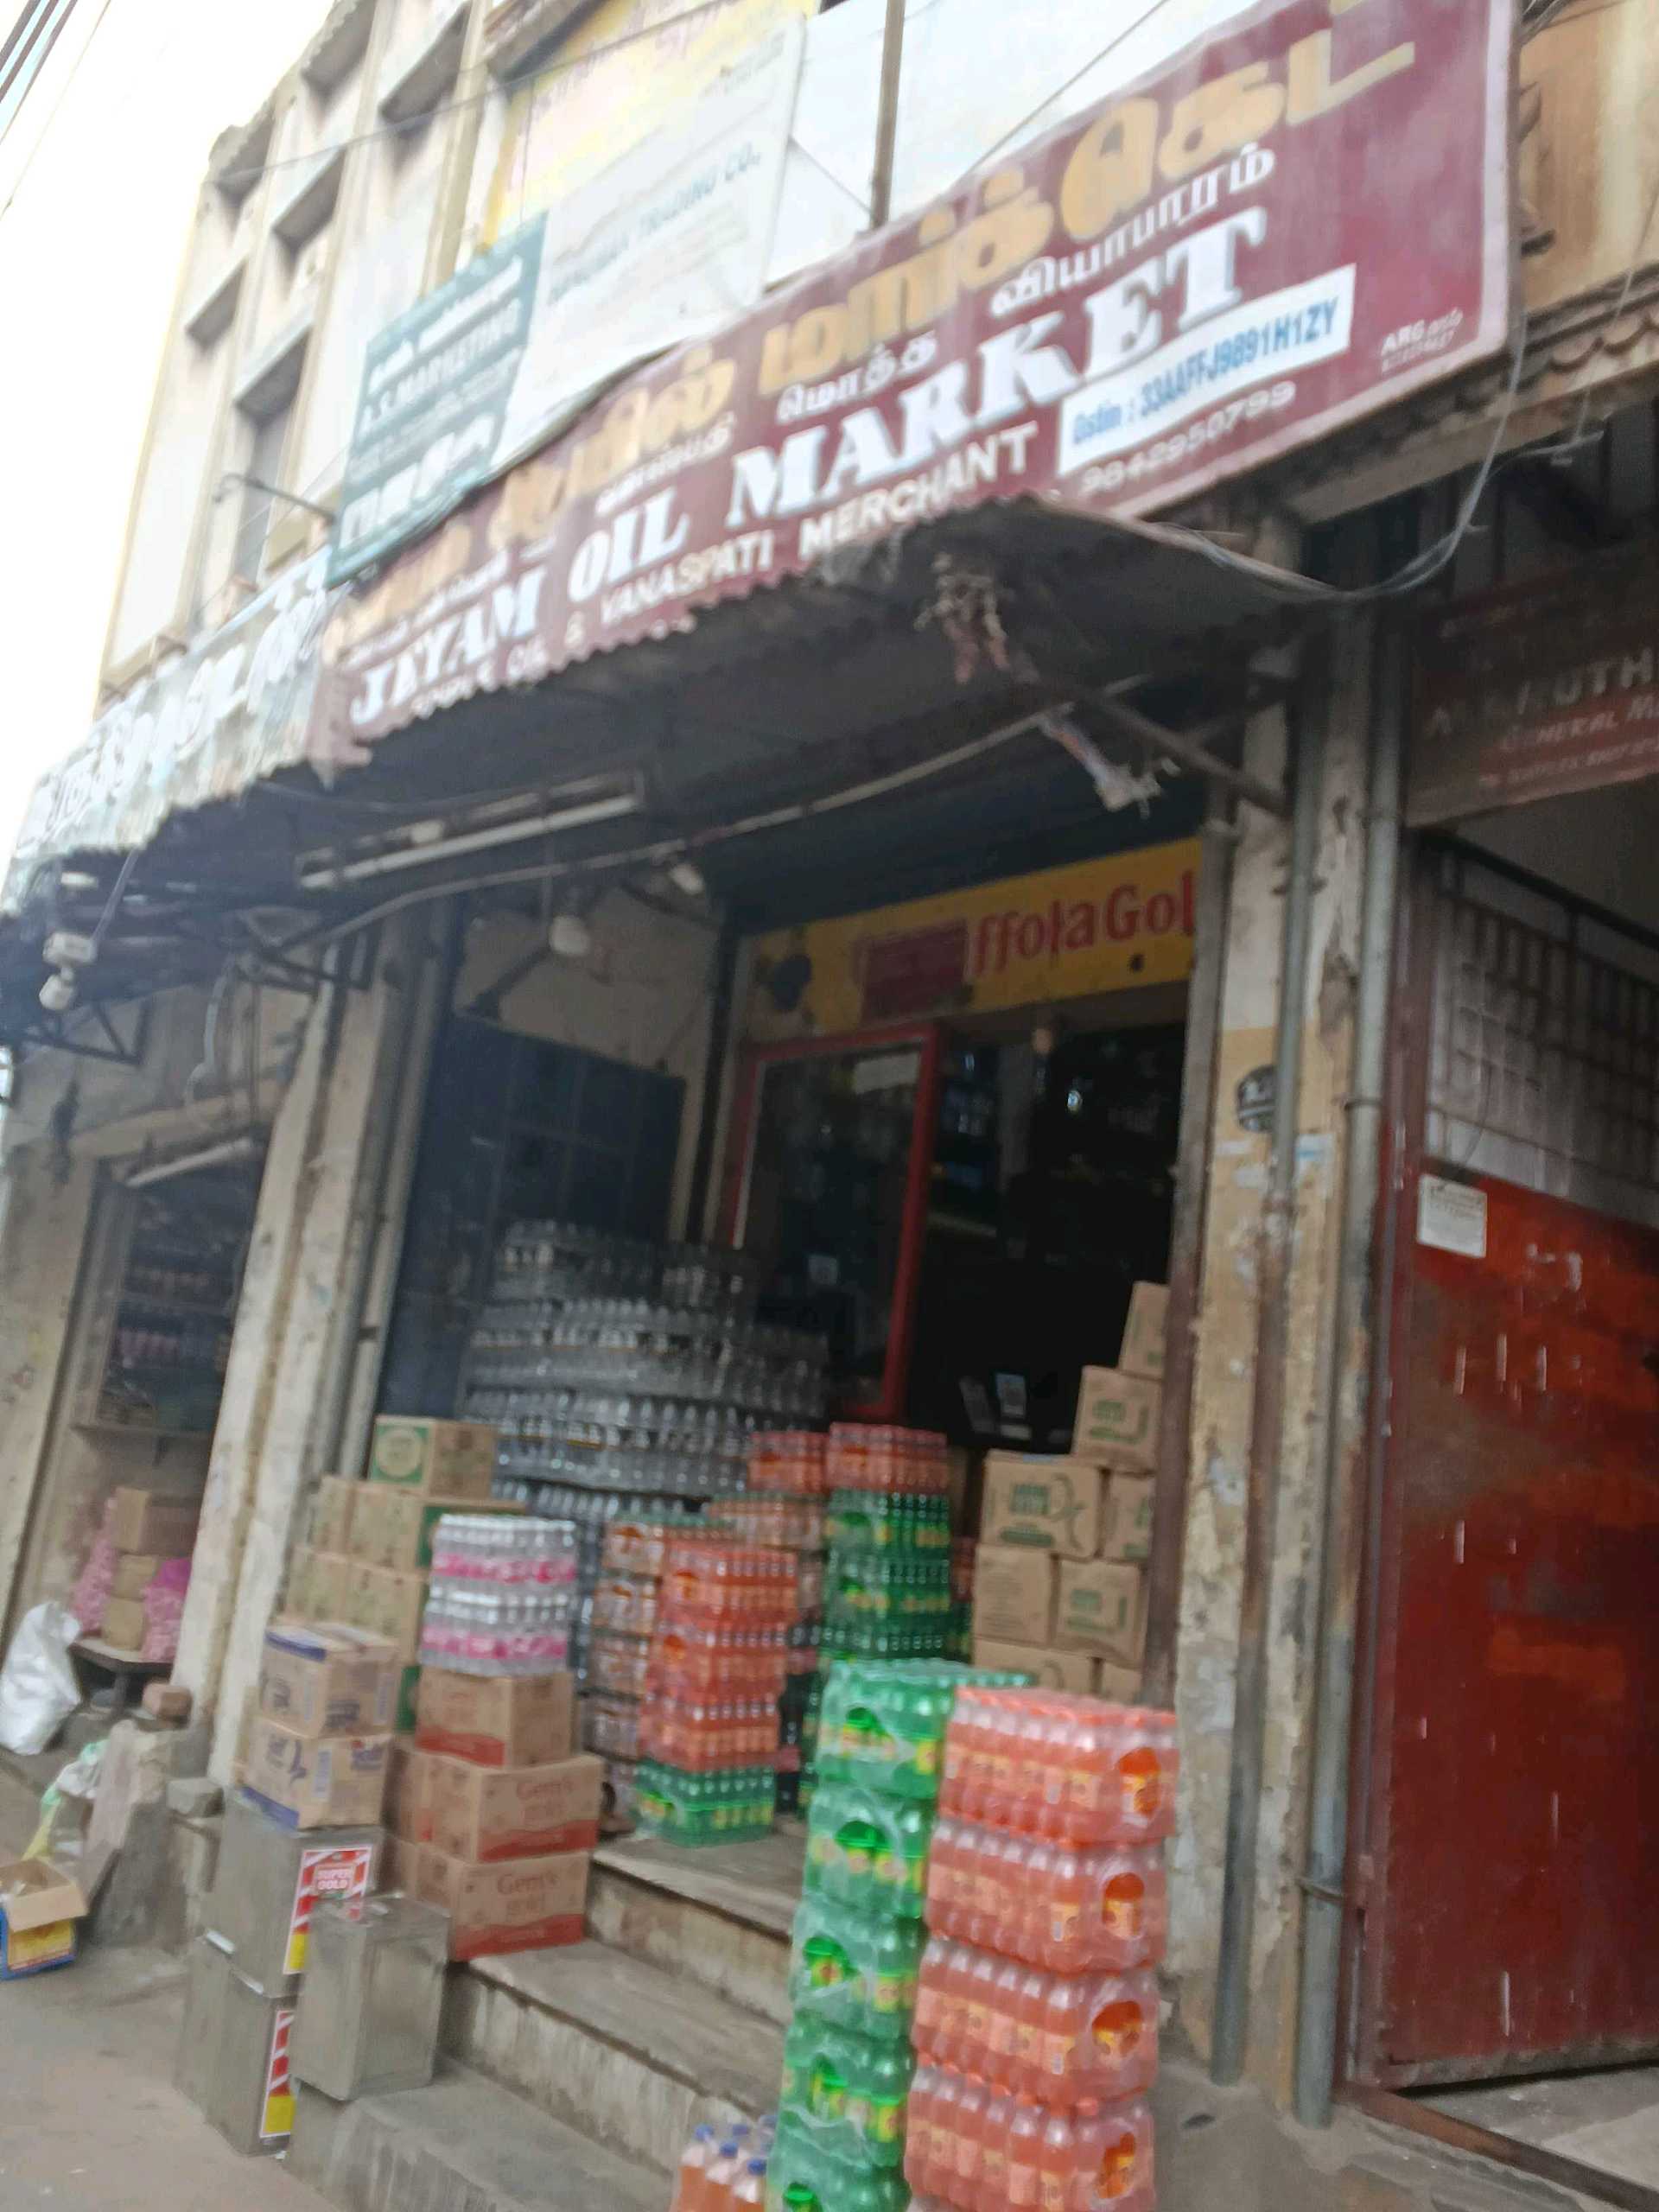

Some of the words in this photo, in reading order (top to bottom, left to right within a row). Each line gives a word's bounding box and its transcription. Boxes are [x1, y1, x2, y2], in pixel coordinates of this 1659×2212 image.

[567, 484, 690, 602] OIL
[724, 207, 1268, 528] MARKET
[776, 330, 938, 425] மொத்த
[991, 143, 1276, 318] வியாபாரம்
[600, 527, 774, 627] VANASPATI
[798, 420, 1039, 561] MERCHANT
[971, 869, 1198, 976] ffolaGol
